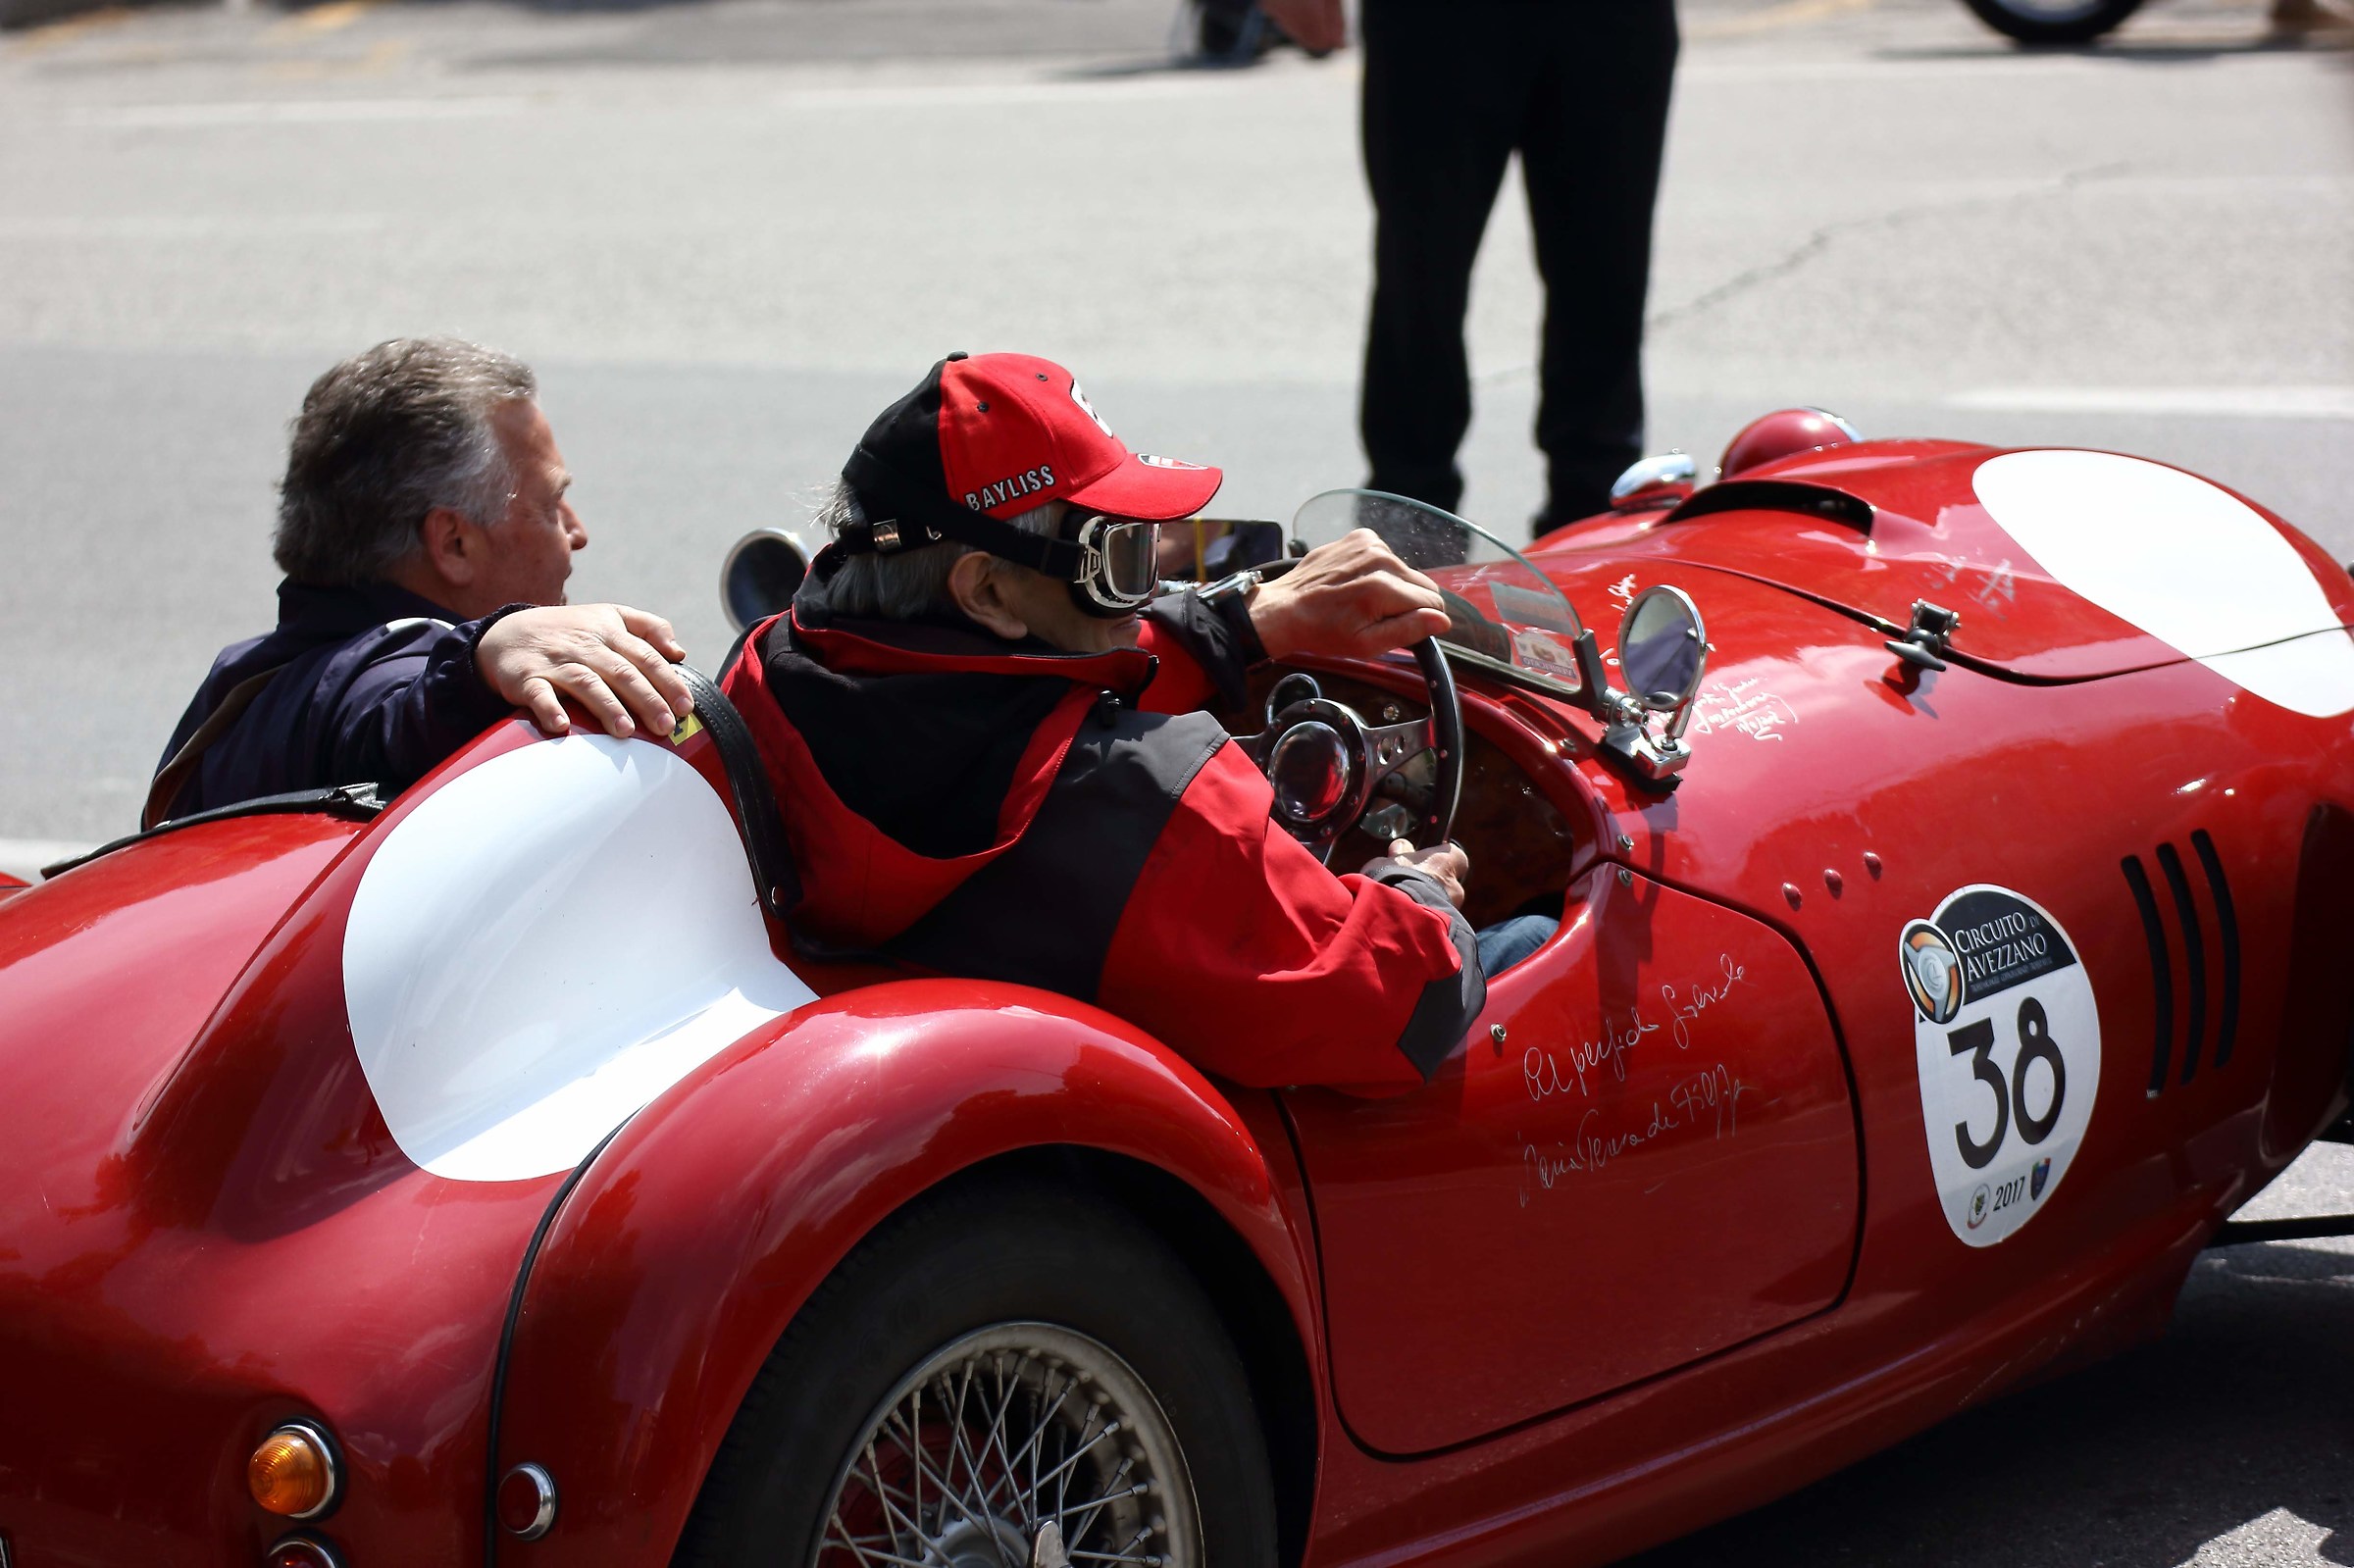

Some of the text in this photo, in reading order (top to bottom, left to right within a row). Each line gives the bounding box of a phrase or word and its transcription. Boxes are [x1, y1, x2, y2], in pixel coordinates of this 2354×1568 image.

[964, 464, 1055, 511] BAYLISS
[1954, 911, 2026, 954] CIRCUITO
[1966, 933, 2047, 982] AVEZZANO
[1946, 996, 2067, 1170] 38
[1992, 1175, 2026, 1212] 2017
